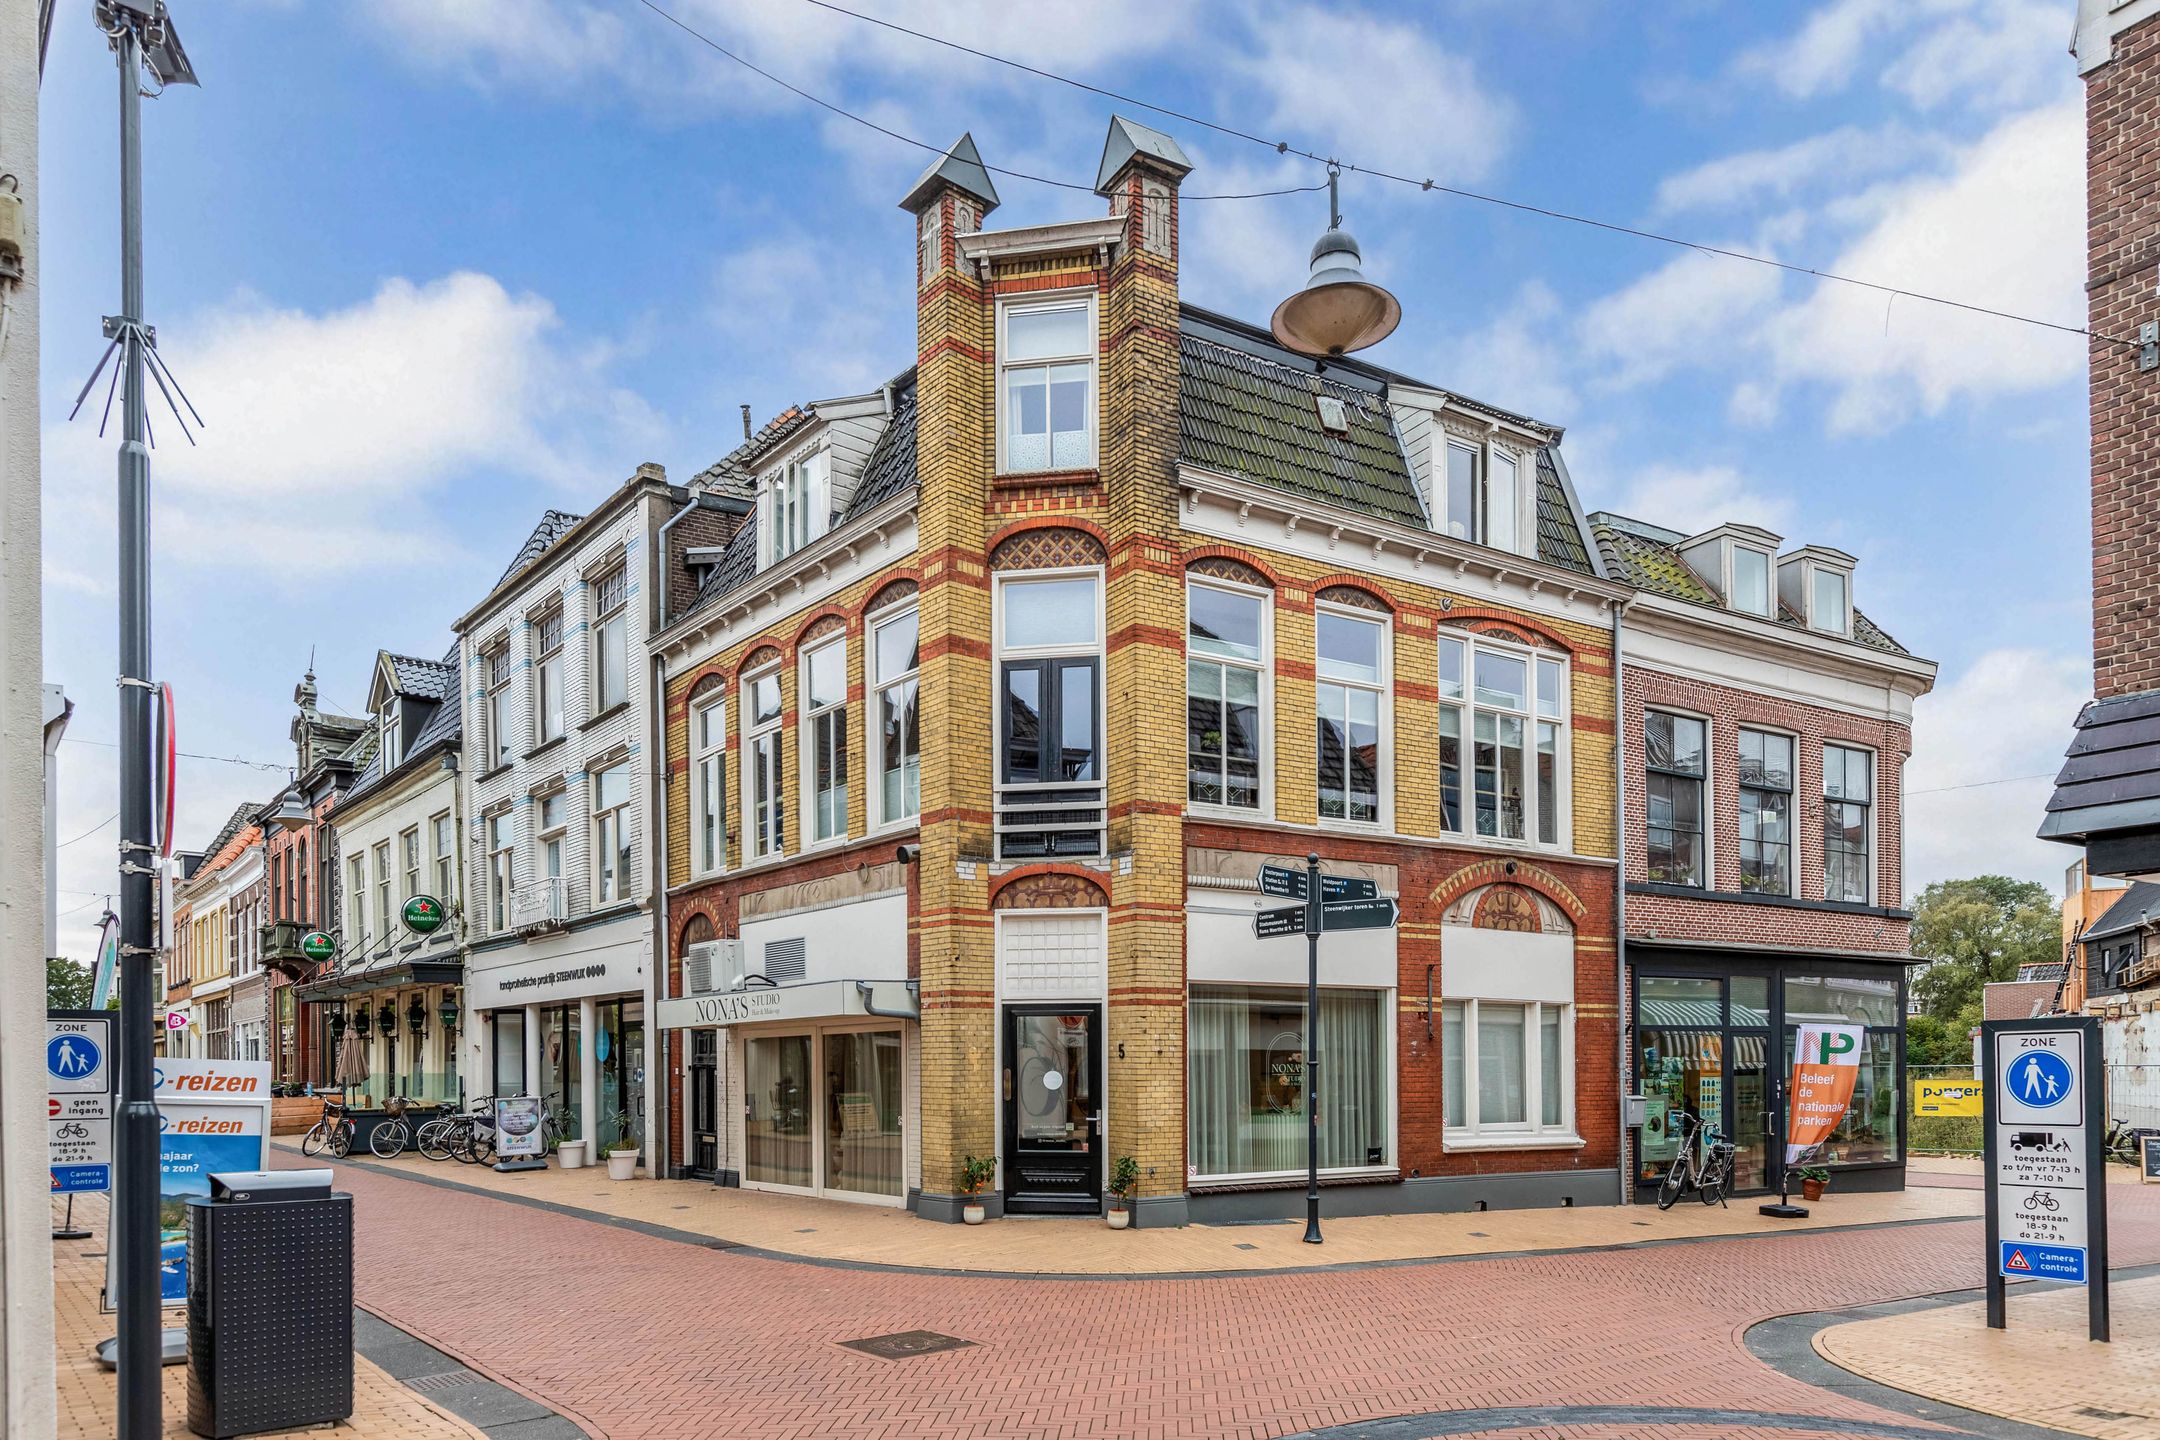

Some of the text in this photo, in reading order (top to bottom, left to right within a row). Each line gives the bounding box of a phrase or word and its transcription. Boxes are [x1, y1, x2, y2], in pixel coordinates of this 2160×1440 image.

[556, 967, 586, 982] STEENWIJK
[752, 993, 780, 1006] STUDIO
[696, 996, 749, 1022] NONA'S
[2020, 1038, 2056, 1046] ZONE
[1118, 1044, 1125, 1059] 5
[1802, 1032, 1854, 1066] NP
[1800, 1073, 1835, 1085] Beleef
[1799, 1087, 1813, 1098] de
[1923, 1088, 1983, 1100] ponger
[68, 1108, 104, 1116] ingang
[1798, 1102, 1844, 1112] nationale
[1797, 1115, 1832, 1126] parken
[2014, 1155, 2068, 1164] toegestaan
[172, 1164, 200, 1173] zon?
[2016, 1212, 2068, 1222] toegestaan
[2040, 1252, 2078, 1262] Camera-
[2041, 1264, 2078, 1273] controle
